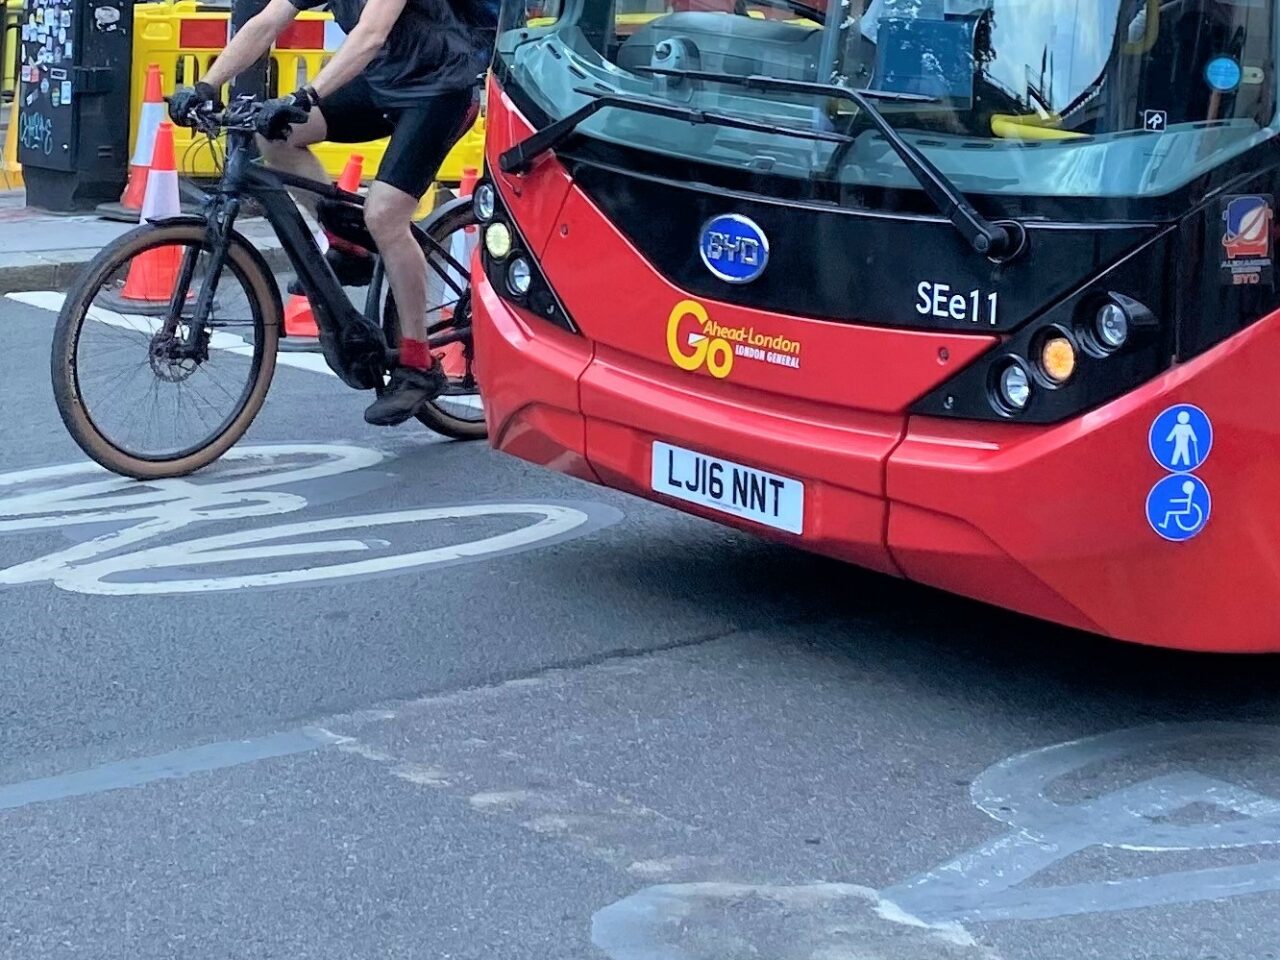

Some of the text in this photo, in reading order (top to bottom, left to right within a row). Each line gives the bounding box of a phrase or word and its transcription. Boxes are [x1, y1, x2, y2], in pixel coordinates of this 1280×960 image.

[707, 231, 759, 266] BYD
[916, 281, 998, 325] SEe11
[667, 300, 734, 379] Go
[735, 344, 800, 369] LONDON GENERAL
[668, 450, 785, 517] LJ16 NNT
